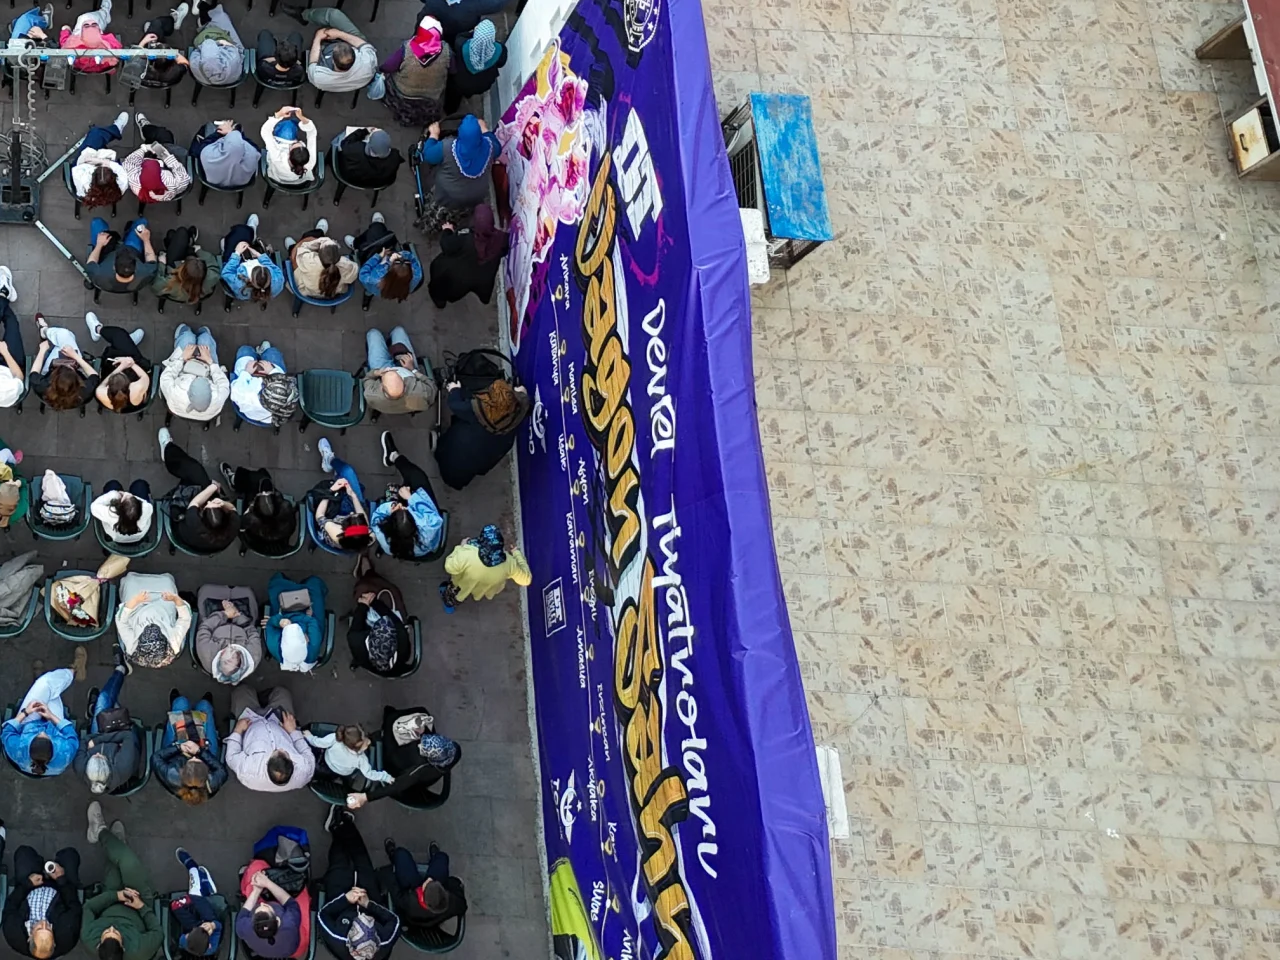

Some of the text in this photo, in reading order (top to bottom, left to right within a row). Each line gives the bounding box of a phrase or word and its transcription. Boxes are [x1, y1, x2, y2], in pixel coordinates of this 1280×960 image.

[612, 107, 664, 242] DT
[559, 253, 571, 310] Ankara
[566, 512, 579, 584] Karaman
